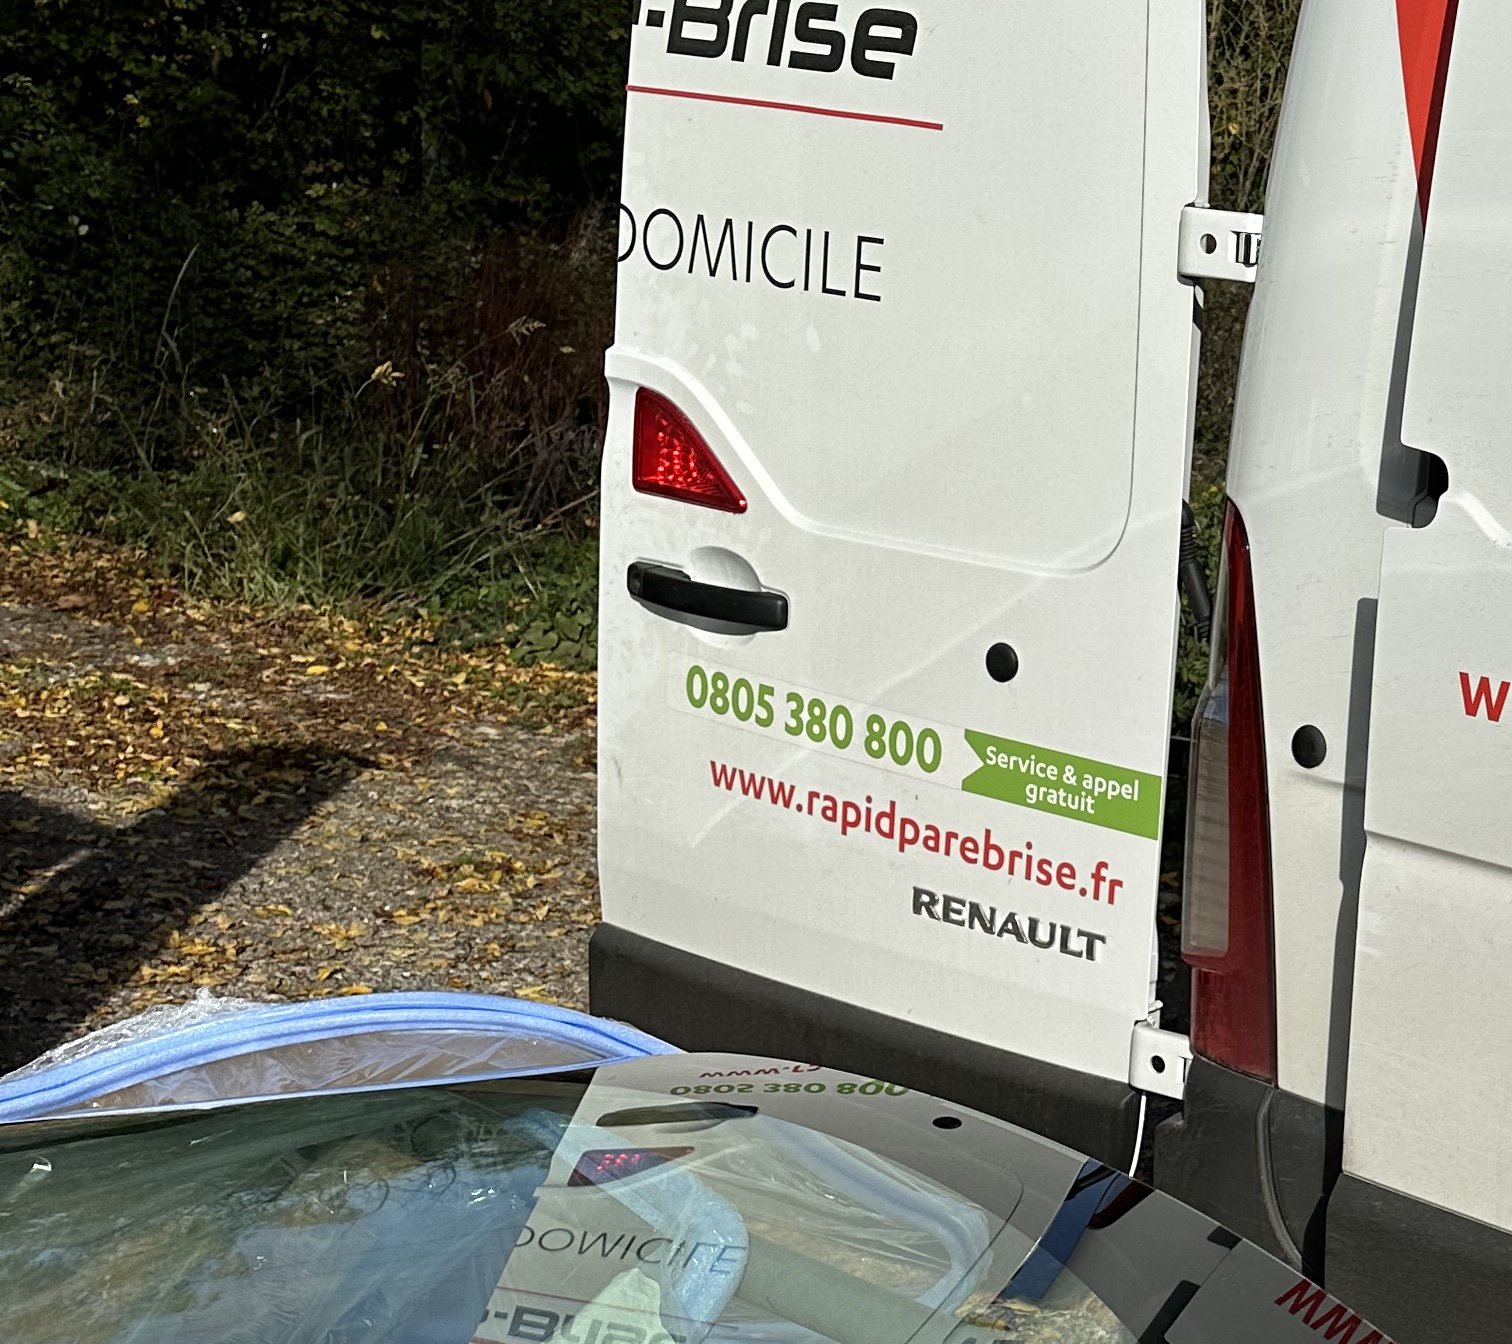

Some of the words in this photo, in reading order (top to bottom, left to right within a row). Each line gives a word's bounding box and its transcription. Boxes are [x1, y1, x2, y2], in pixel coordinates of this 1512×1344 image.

[686, 664, 775, 728] 0805
[784, 692, 854, 750] 380
[863, 713, 942, 774] 800
[985, 745, 1058, 782] Service
[1062, 764, 1078, 787] &
[1081, 770, 1140, 802] appel
[1025, 781, 1096, 815] gratuit
[709, 759, 1123, 906] www.rapidparebrise.fr
[911, 885, 1107, 962] RENAULT
